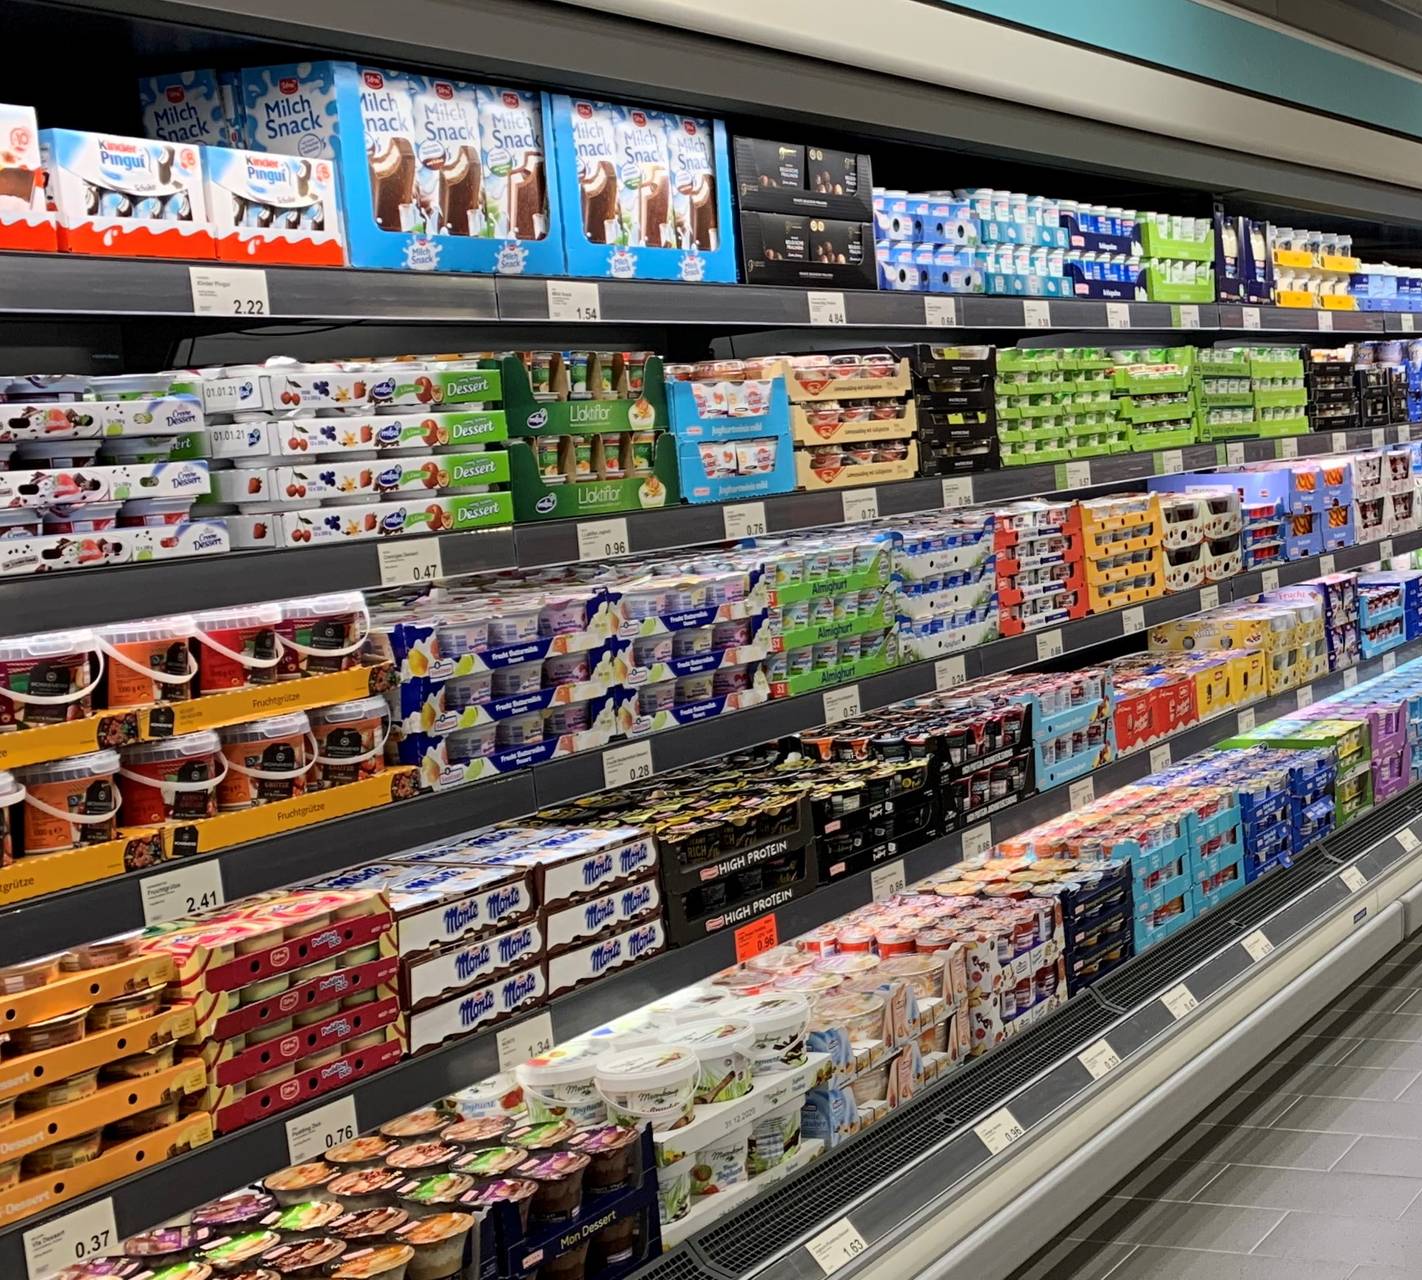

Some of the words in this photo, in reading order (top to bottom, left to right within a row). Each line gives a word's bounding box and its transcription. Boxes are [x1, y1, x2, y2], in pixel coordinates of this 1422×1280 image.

[154, 102, 199, 126] Milch
[264, 95, 312, 120] Milch
[424, 101, 467, 121] Milch
[266, 113, 323, 139] Snack
[365, 112, 408, 133] nack
[490, 110, 532, 129] Milch
[424, 122, 476, 142] Snack
[492, 130, 541, 150] Snack
[623, 127, 659, 147] Milch
[676, 136, 707, 154] Milch
[233, 299, 264, 315] 2.22
[576, 308, 598, 320] 1.54
[205, 385, 237, 399] 01.01.21
[447, 378, 489, 397] Dessert
[213, 429, 245, 442] 01.01.21
[452, 419, 495, 439] Dessert
[453, 460, 496, 480] Dessert
[457, 502, 500, 522] Dessert
[861, 508, 876, 520] 0.72
[746, 522, 764, 536] 0.76
[605, 541, 625, 556] 0.96
[412, 564, 438, 581] 0.47
[811, 579, 848, 596] Almighurt
[817, 623, 853, 640] Almighurt
[820, 666, 856, 683] Almighurt
[252, 691, 301, 709] Fruchtgrütze
[630, 764, 650, 781] 0.28
[276, 802, 325, 822] Fruchtgrütze
[619, 842, 649, 872] Monte
[718, 855, 746, 876] HIGH
[746, 840, 788, 865] PROTEIN
[582, 854, 613, 885] Monte
[186, 890, 217, 913] 2.41
[486, 890, 520, 919] Monte
[621, 885, 650, 915] Monte
[724, 904, 751, 926] HIGH
[752, 888, 793, 914] PROTEIN
[444, 903, 479, 935] Monte
[585, 898, 615, 930] Monte
[497, 929, 532, 960] Monte
[628, 926, 656, 955] Monte
[757, 934, 775, 951] 0.96
[455, 945, 491, 980] Monte
[590, 940, 621, 972] Monte
[502, 974, 536, 1007] Monte
[458, 991, 494, 1026] Monte
[527, 1039, 551, 1058] 1.34
[325, 1125, 354, 1148] 0.76
[1004, 1125, 1023, 1142] 0.96
[559, 1228, 583, 1250] Mon
[583, 1210, 618, 1240] Dessert
[75, 1230, 110, 1259] 0.37
[843, 1238, 865, 1259] 1.63
